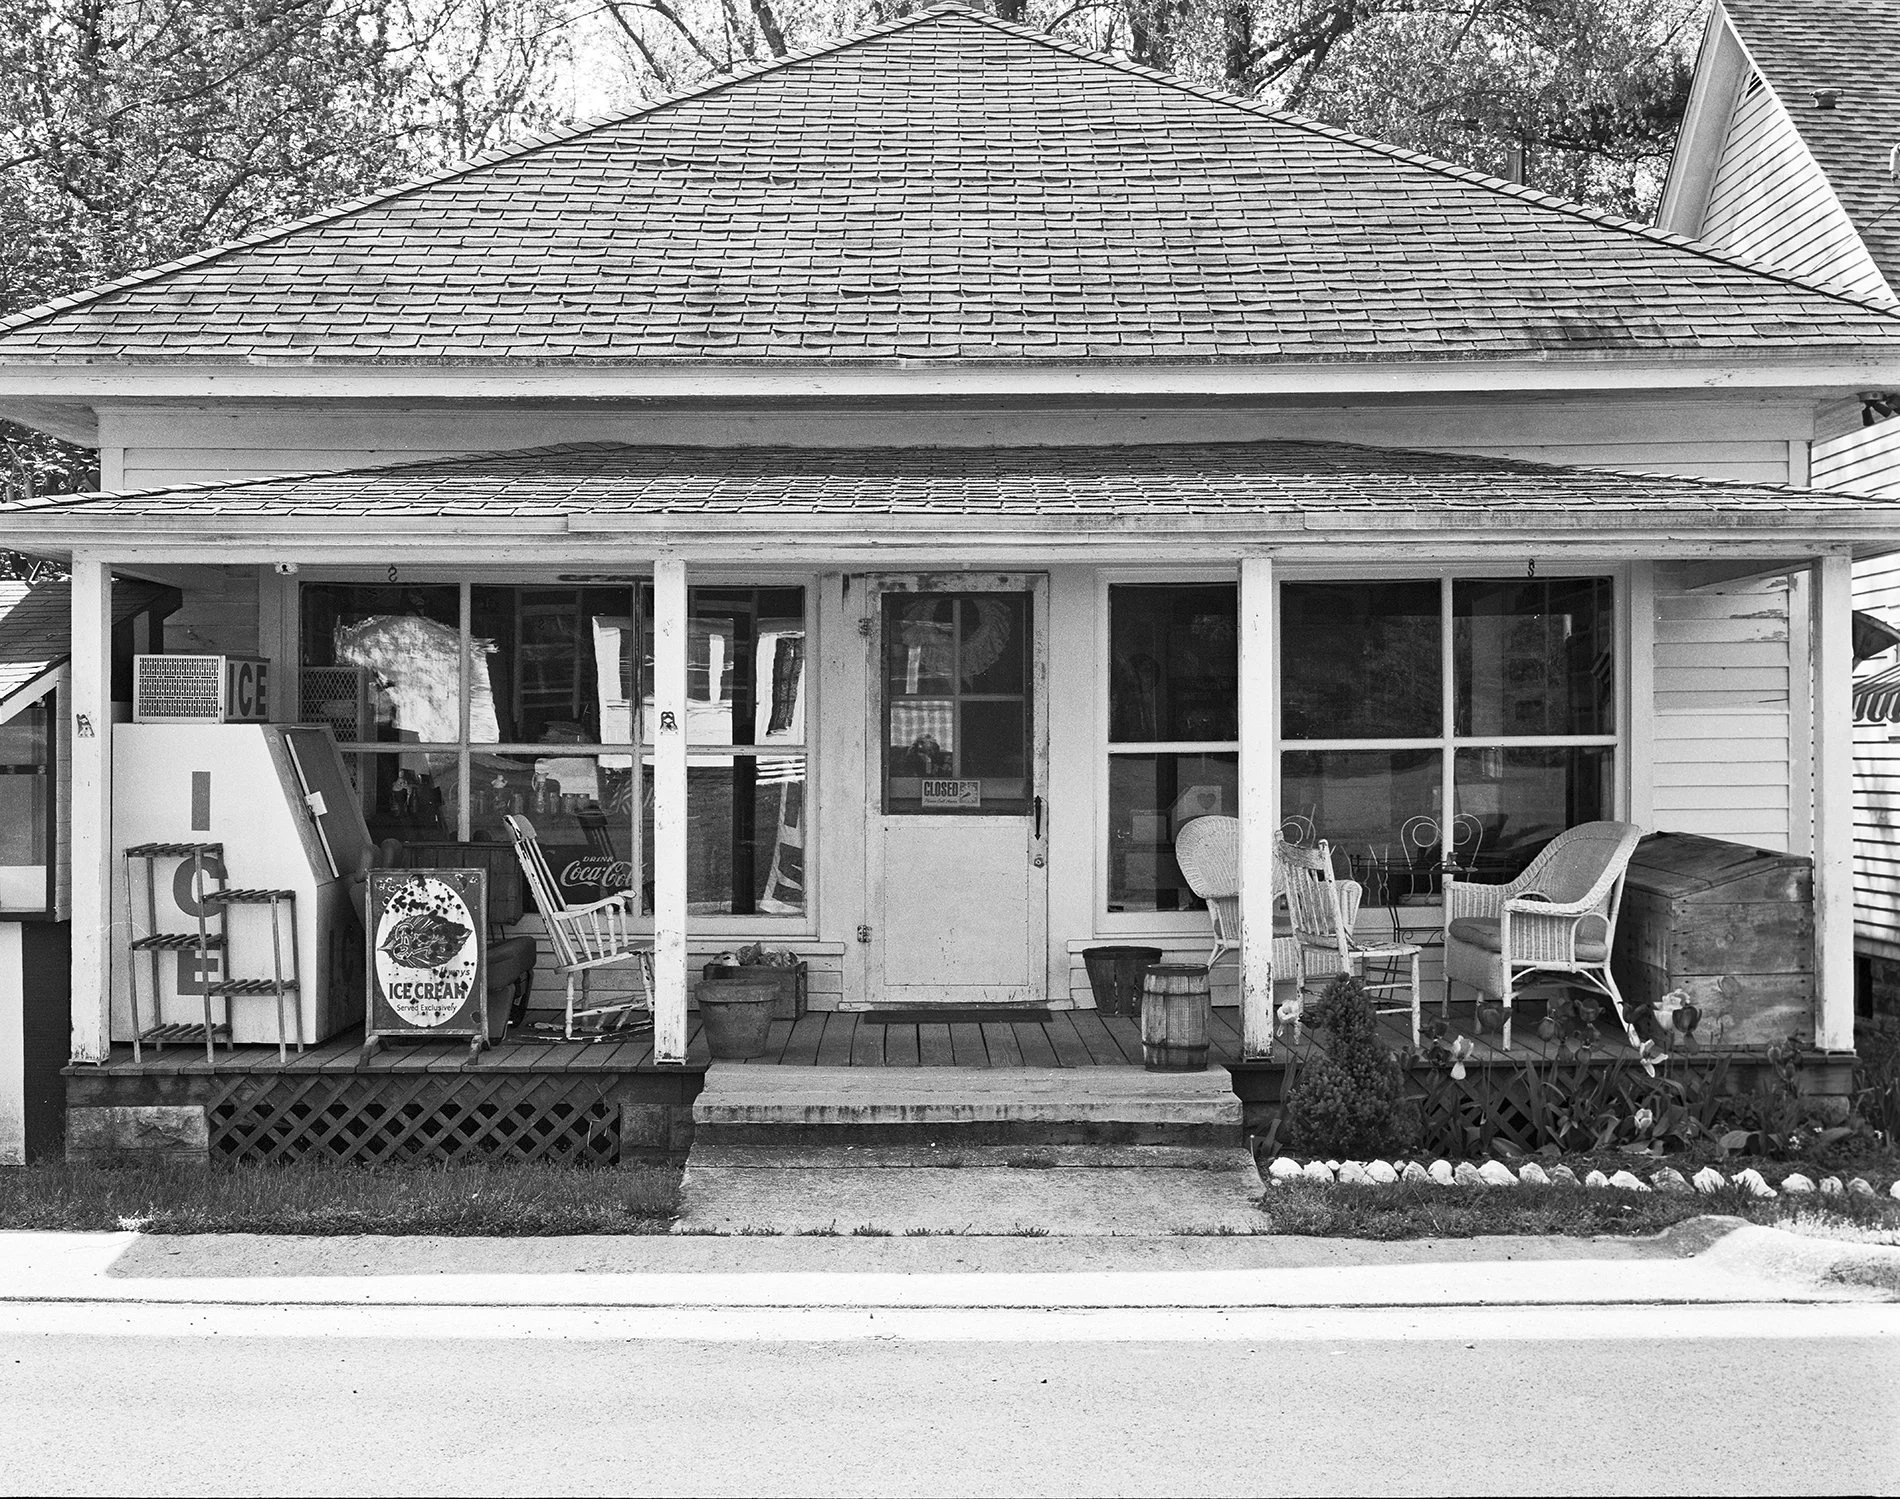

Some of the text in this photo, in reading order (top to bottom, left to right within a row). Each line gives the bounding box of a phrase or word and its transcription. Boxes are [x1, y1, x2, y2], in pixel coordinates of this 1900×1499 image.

[228, 662, 267, 717] ICE
[924, 781, 959, 797] CLOSED
[173, 771, 228, 996] ICE
[560, 860, 648, 888] Coca-Col
[389, 982, 466, 1000] ICE CREAM
[396, 1003, 458, 1014] Served Exclusively
